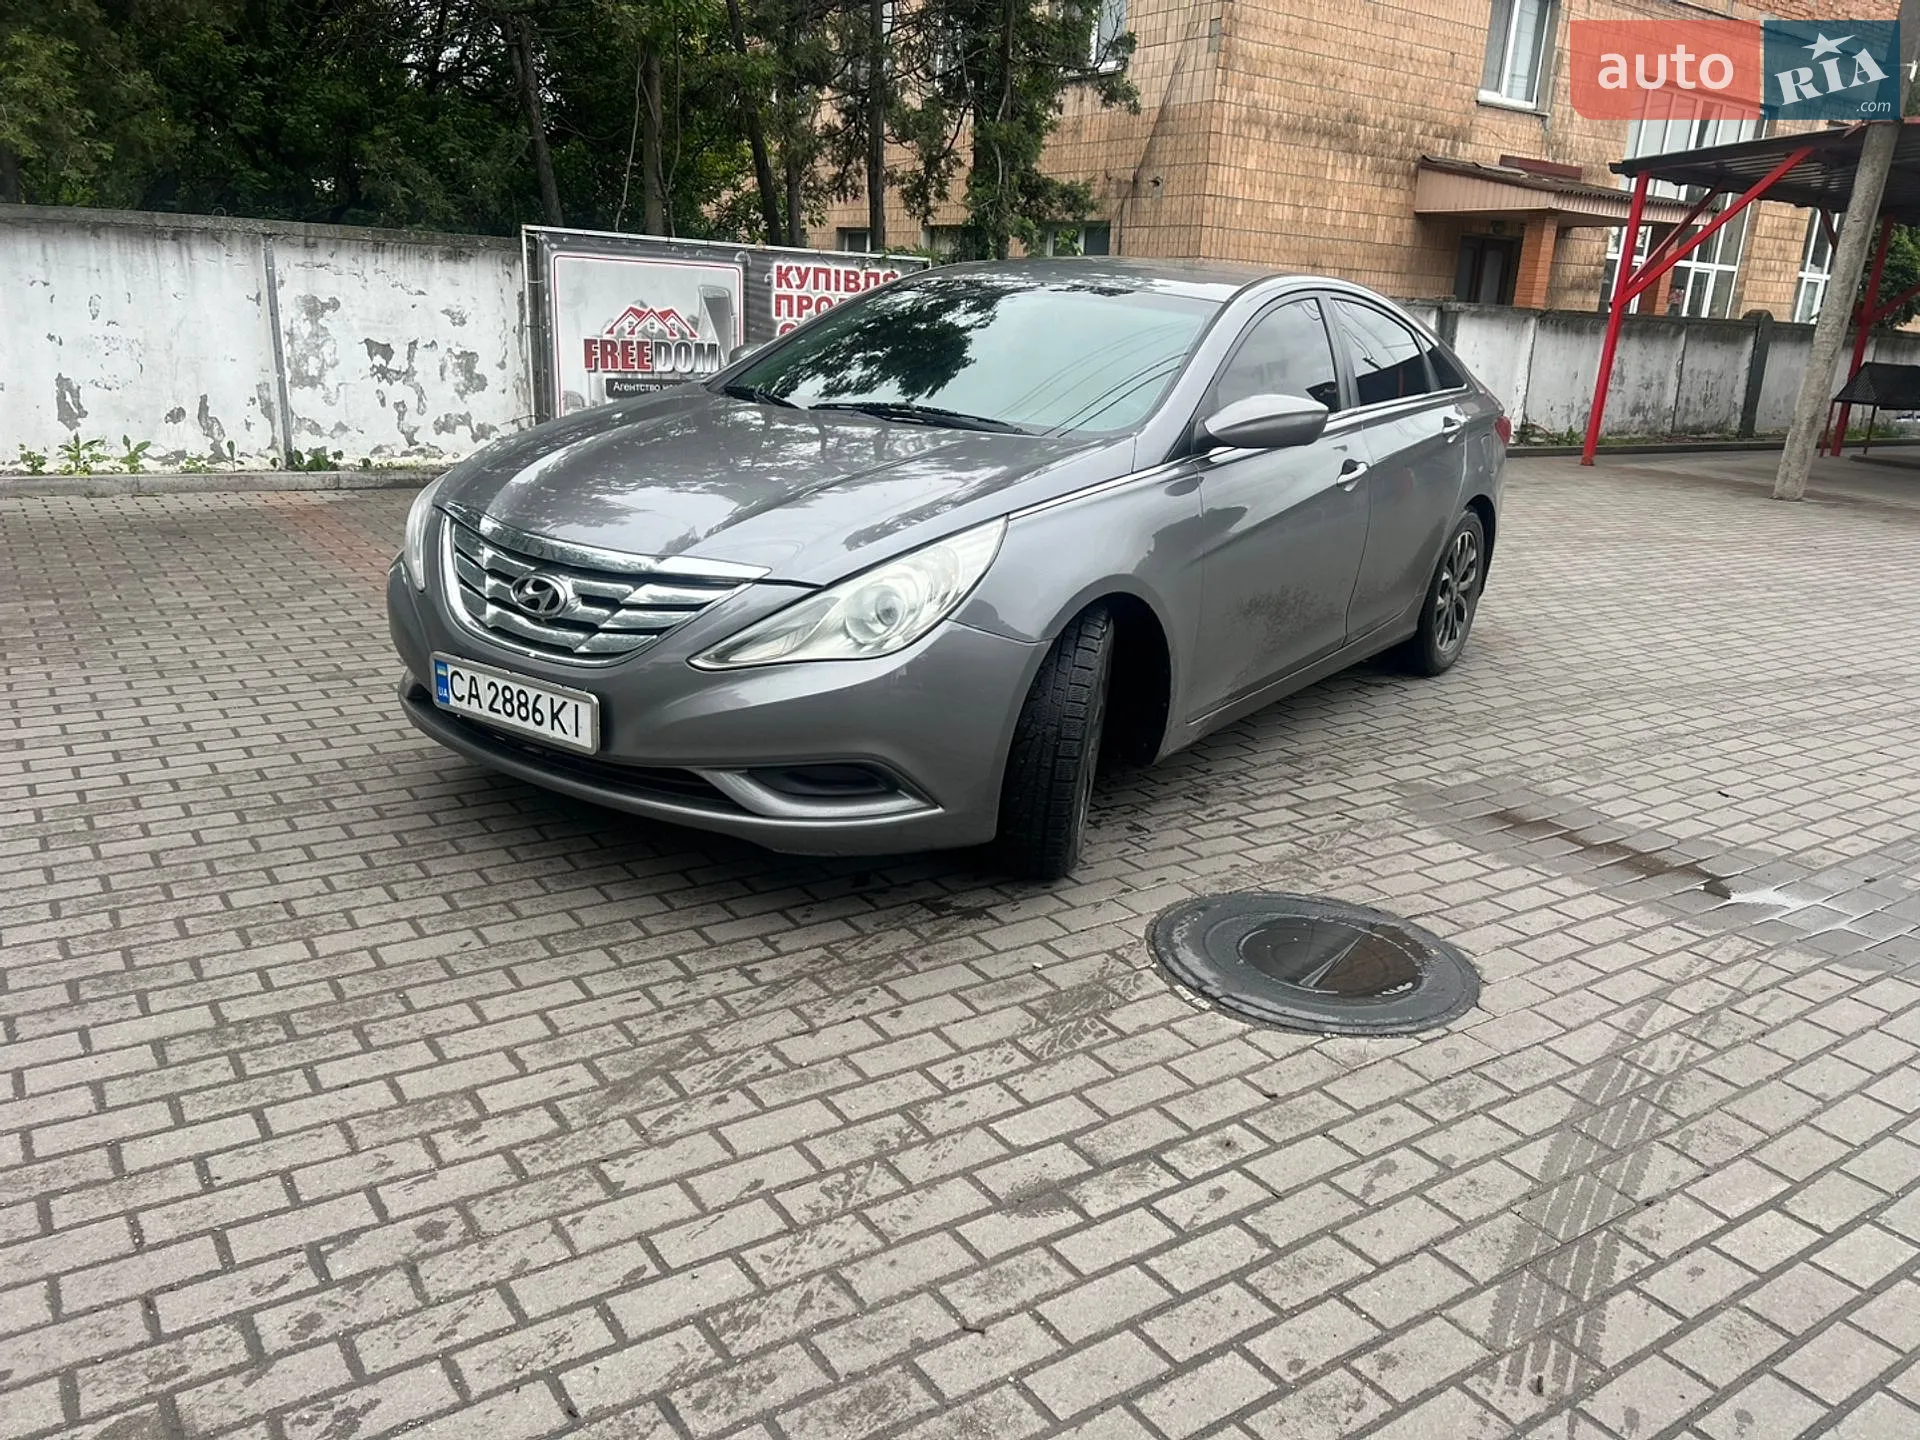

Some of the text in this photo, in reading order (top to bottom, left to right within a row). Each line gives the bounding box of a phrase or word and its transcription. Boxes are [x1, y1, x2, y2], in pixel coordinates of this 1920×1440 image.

[775, 294, 848, 318] ПРО
[584, 339, 719, 373] FREEDOM
[613, 381, 661, 393] Агентство
